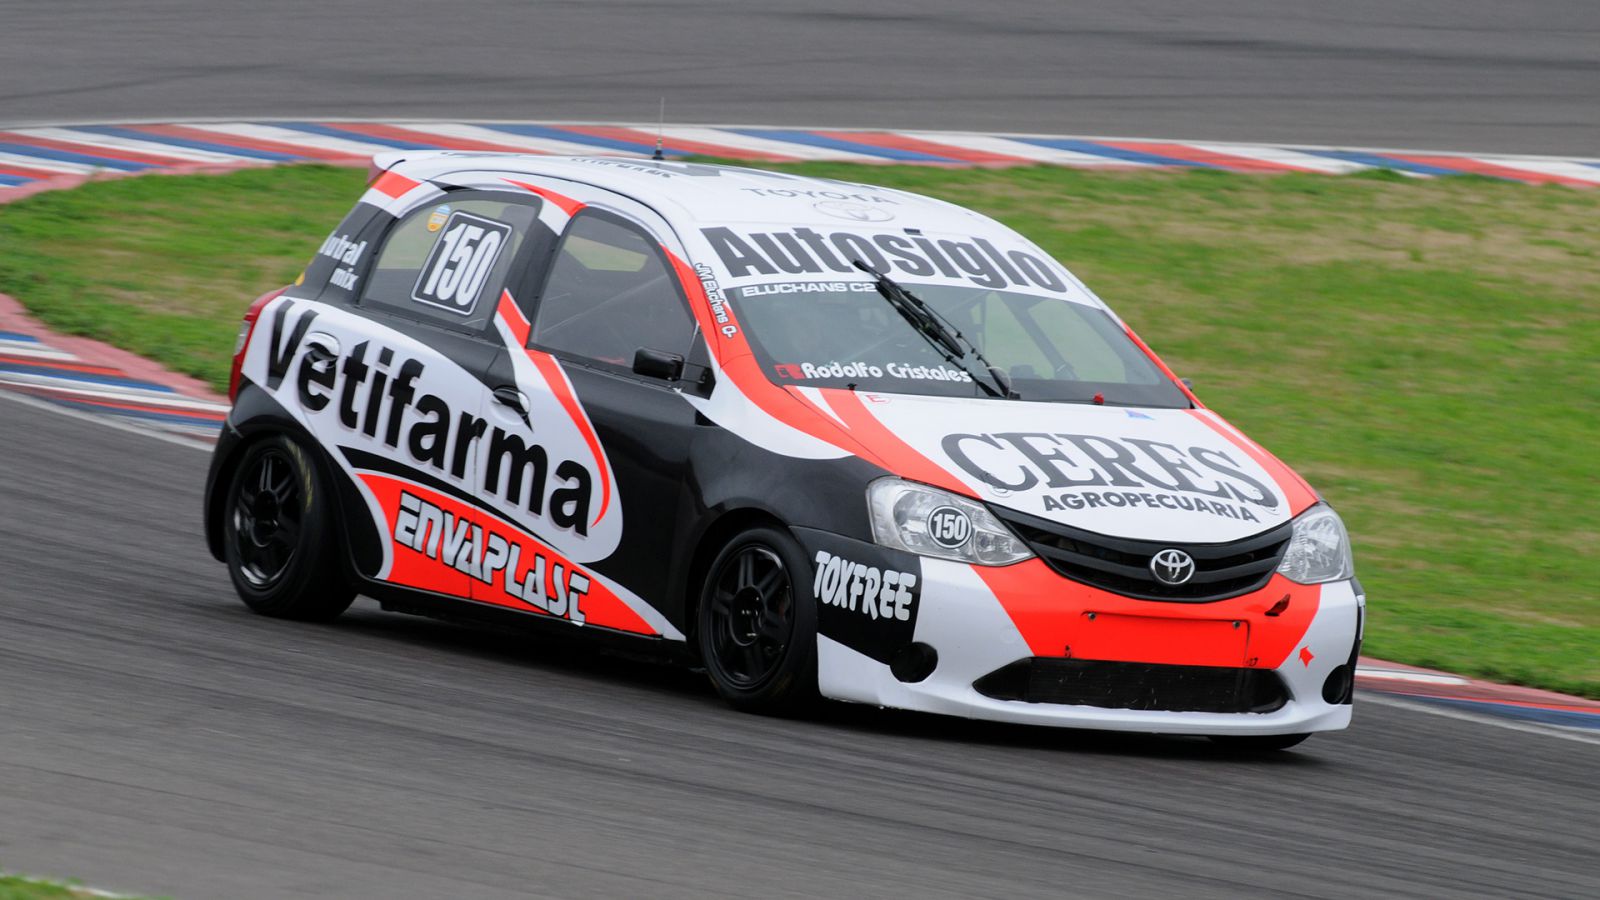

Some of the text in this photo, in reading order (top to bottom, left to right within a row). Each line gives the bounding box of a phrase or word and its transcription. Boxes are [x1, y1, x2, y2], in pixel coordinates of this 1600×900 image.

[741, 187, 901, 205] TOYOTA
[424, 223, 502, 306] 150
[700, 226, 1068, 294] Autosiglo
[329, 267, 360, 291] mix
[741, 282, 848, 298] ELUCHANS
[800, 361, 973, 384] Rodolfo Cristales
[267, 299, 592, 537] Vetifarma
[940, 432, 1280, 508] CERES
[1042, 491, 1261, 524] AGROPECUARIA
[933, 513, 967, 540] 150
[813, 550, 917, 621] TOXFREE
